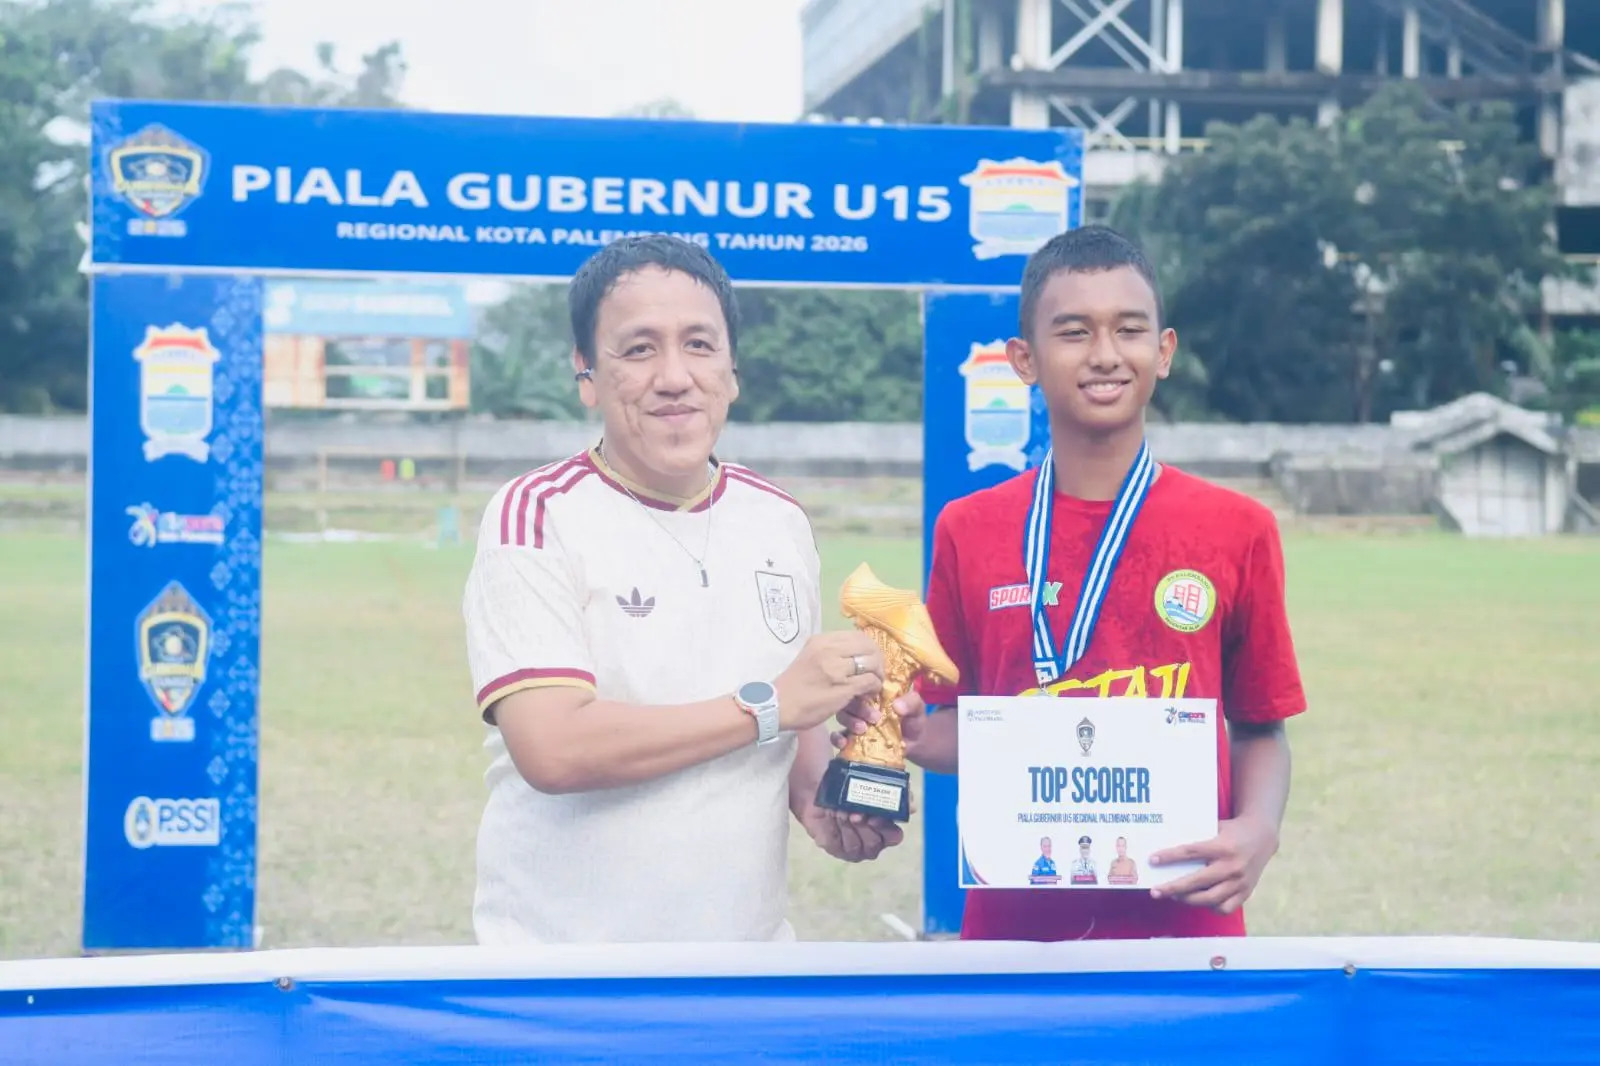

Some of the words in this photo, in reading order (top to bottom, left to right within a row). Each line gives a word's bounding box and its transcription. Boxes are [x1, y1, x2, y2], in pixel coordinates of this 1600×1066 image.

[232, 165, 429, 208] PIALA
[447, 172, 814, 219] GUBERNUR
[834, 184, 951, 222] U15
[337, 223, 468, 243] REGIONAL
[476, 228, 546, 244] KOTA
[716, 233, 805, 251] TAHUN
[811, 236, 868, 252] 2026
[1027, 766, 1067, 803] TOP
[1071, 766, 1151, 804] SCORER
[1018, 813, 1034, 823] PIALA
